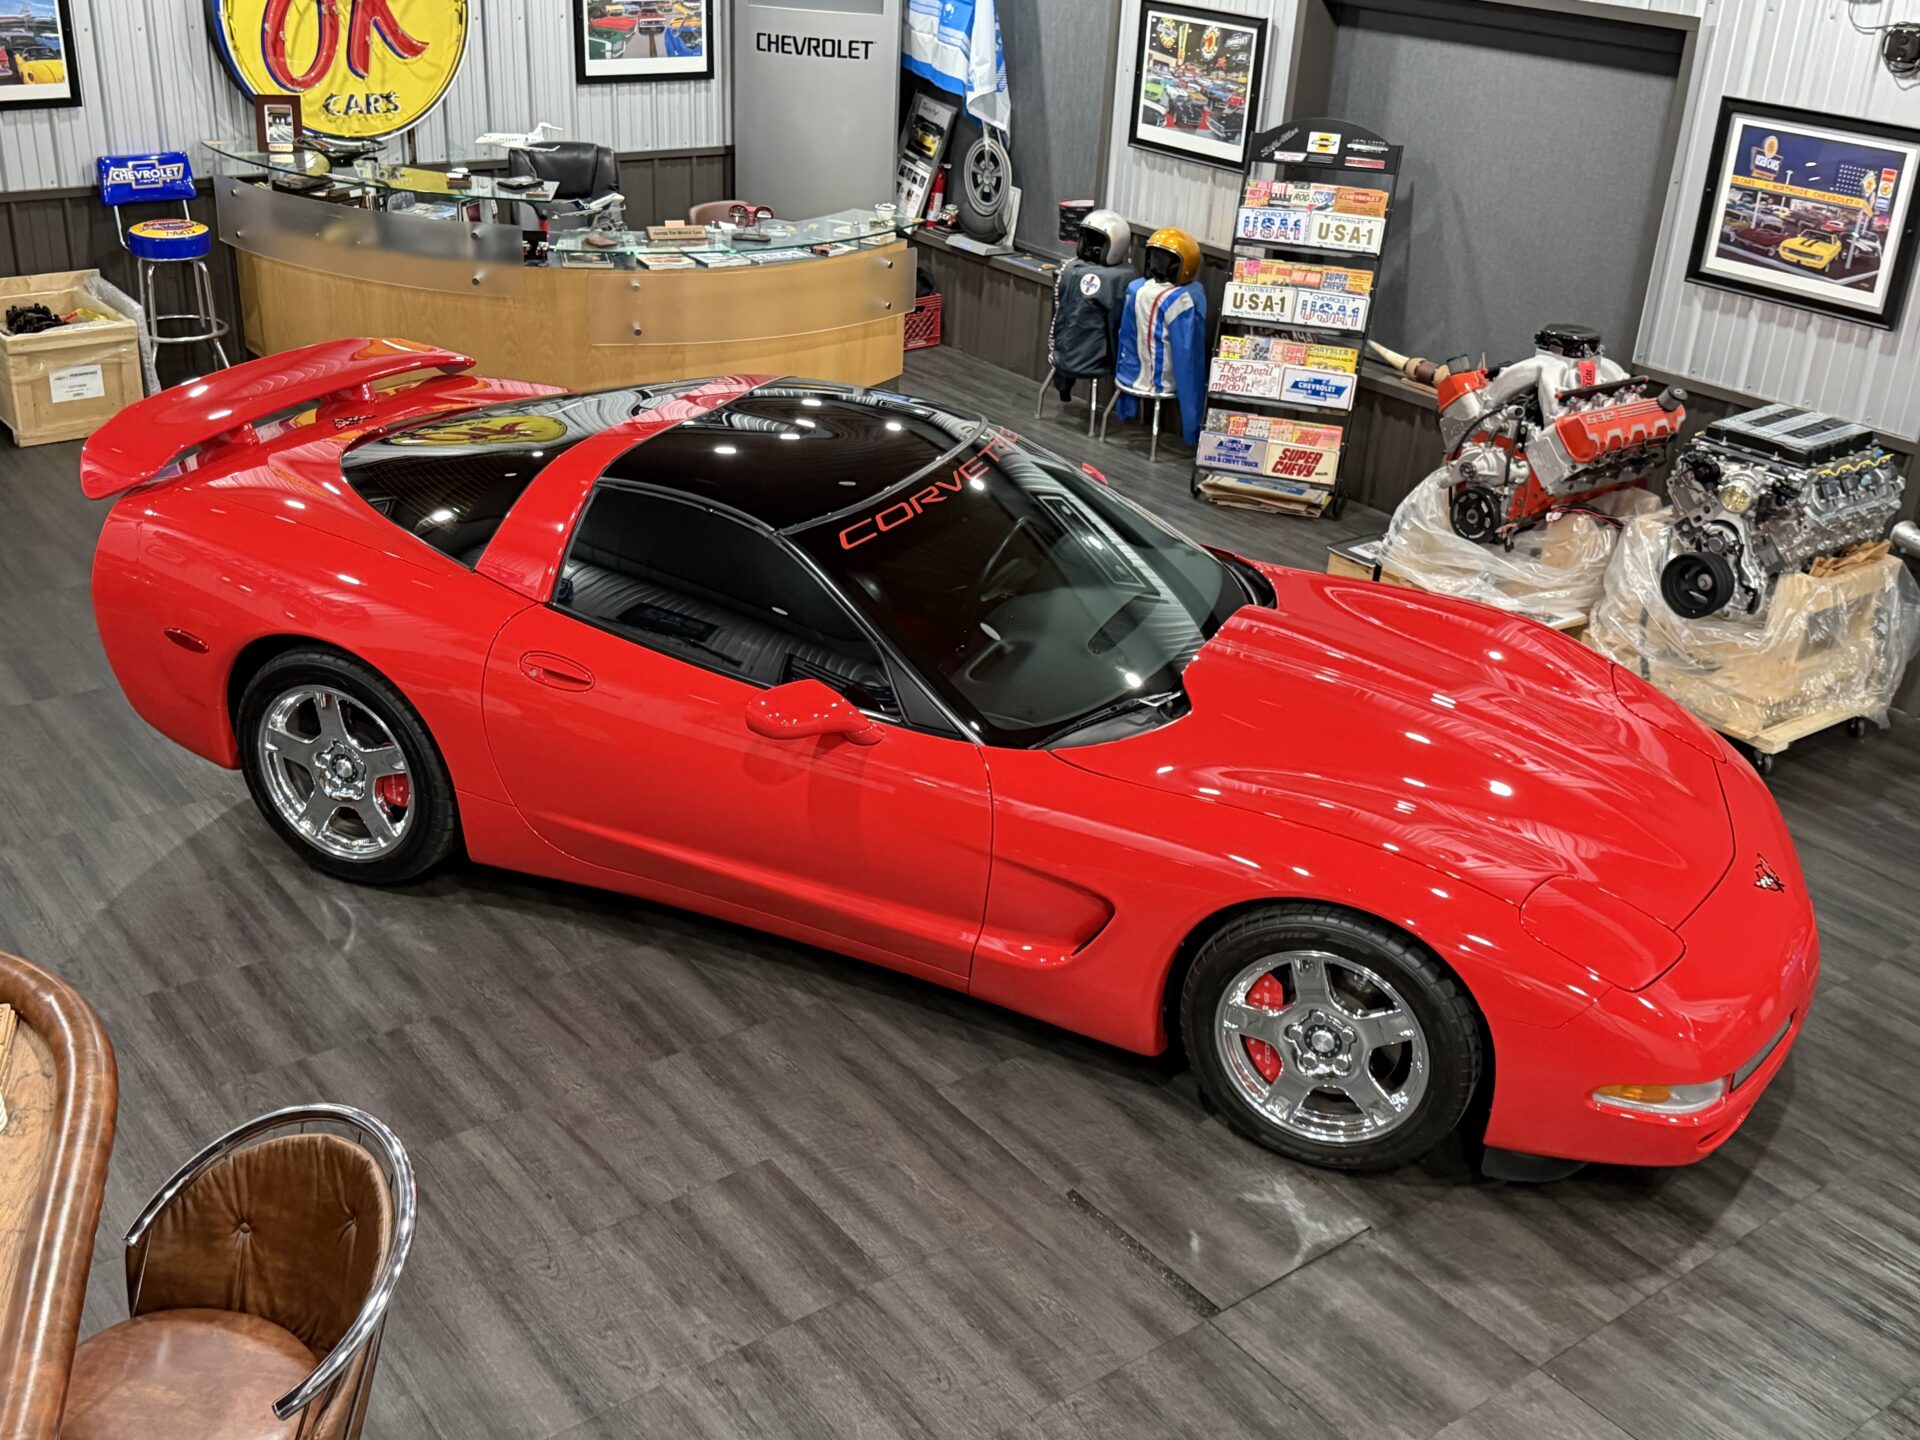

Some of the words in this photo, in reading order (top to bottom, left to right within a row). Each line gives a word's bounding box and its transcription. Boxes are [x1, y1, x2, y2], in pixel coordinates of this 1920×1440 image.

[756, 32, 874, 60] CHEVROLET
[323, 91, 401, 116] CARS
[112, 167, 179, 182] CHEVROLET
[1324, 272, 1348, 281] SUPER
[1322, 280, 1346, 291] CHEVY
[1308, 344, 1349, 356] CHRYSLER
[1298, 381, 1336, 393] CHEVROLET
[1279, 447, 1324, 466] SUPER
[1271, 460, 1317, 478] CHEVY
